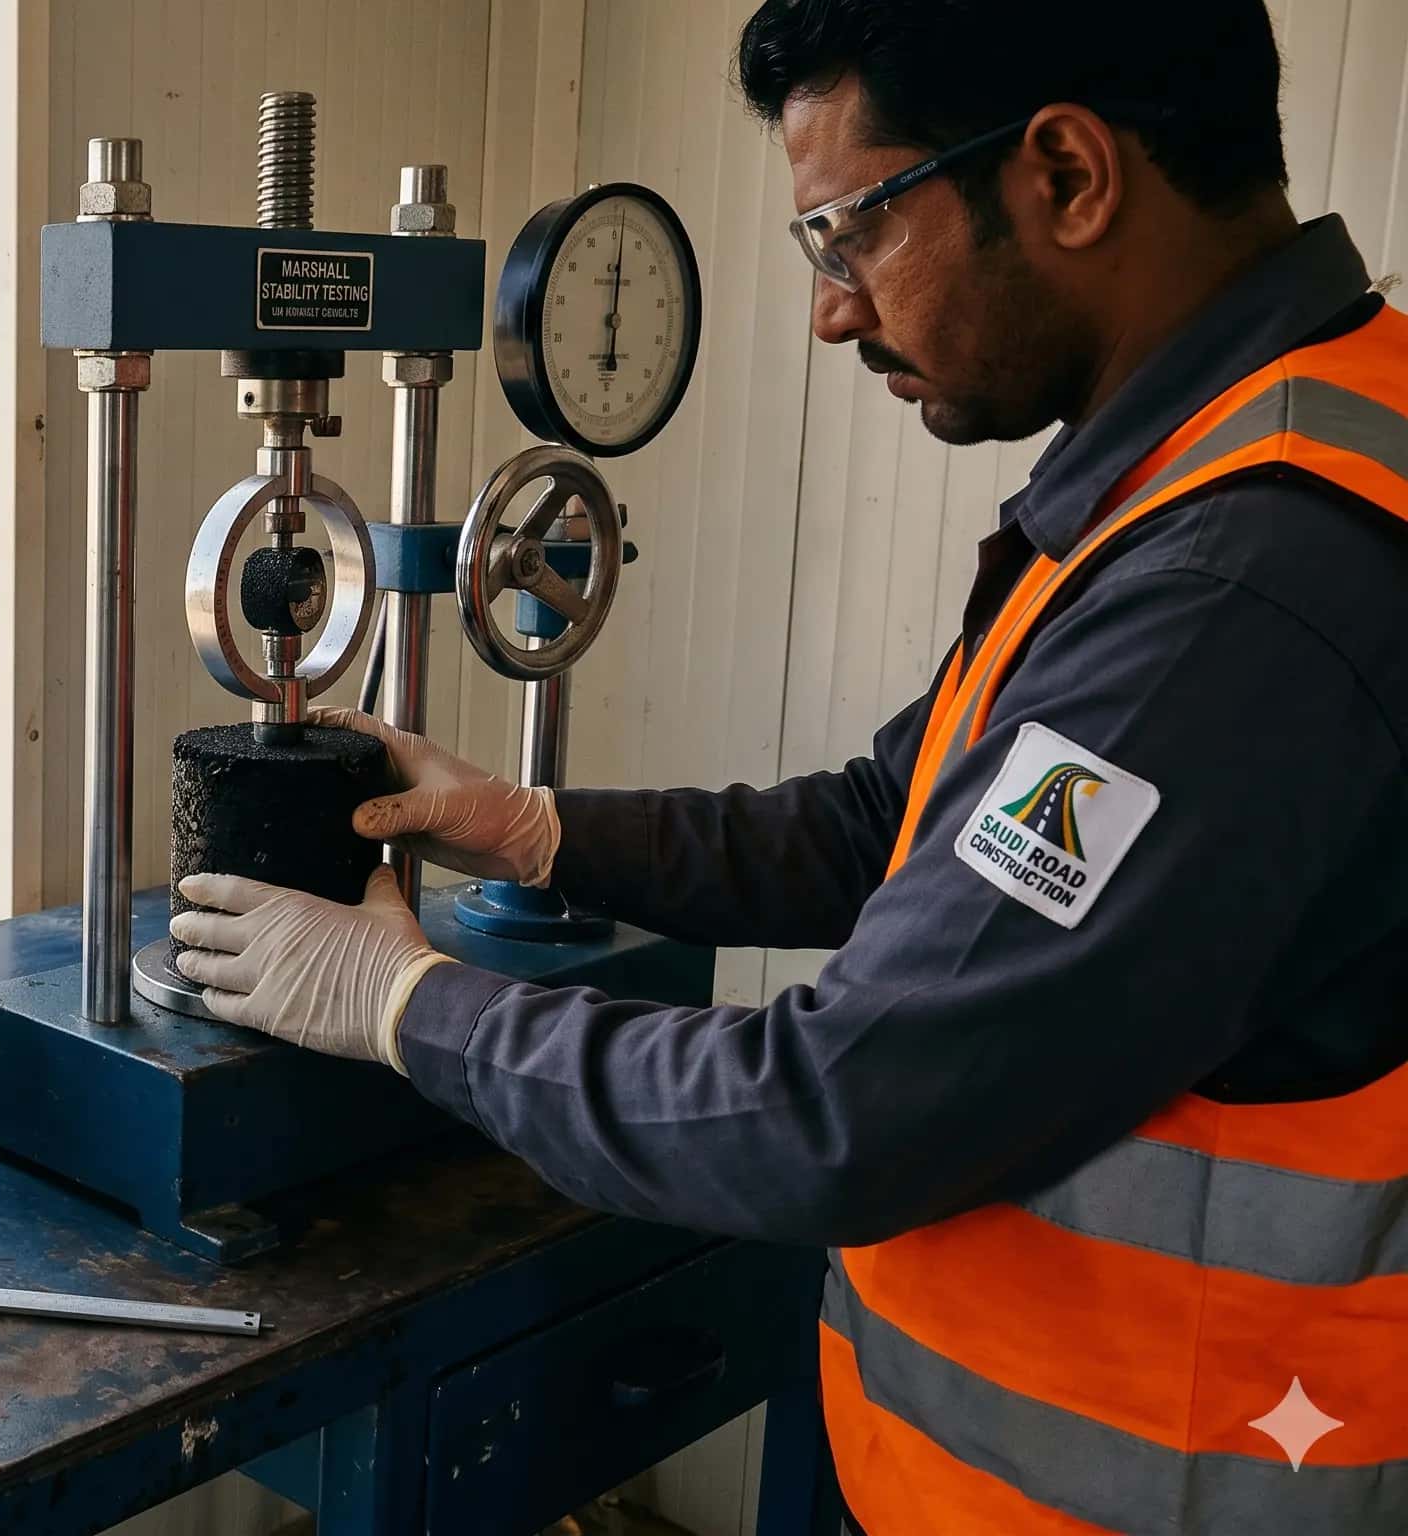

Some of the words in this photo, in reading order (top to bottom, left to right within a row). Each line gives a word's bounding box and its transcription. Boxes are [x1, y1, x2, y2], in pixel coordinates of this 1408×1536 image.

[261, 282, 320, 300] STABILITY
[322, 284, 369, 302] TESTING
[281, 259, 351, 280] MARSHALL
[970, 833, 1077, 908] CONSTRUCTION
[979, 814, 1030, 857] SAUDI
[1027, 846, 1087, 889] ROAD
